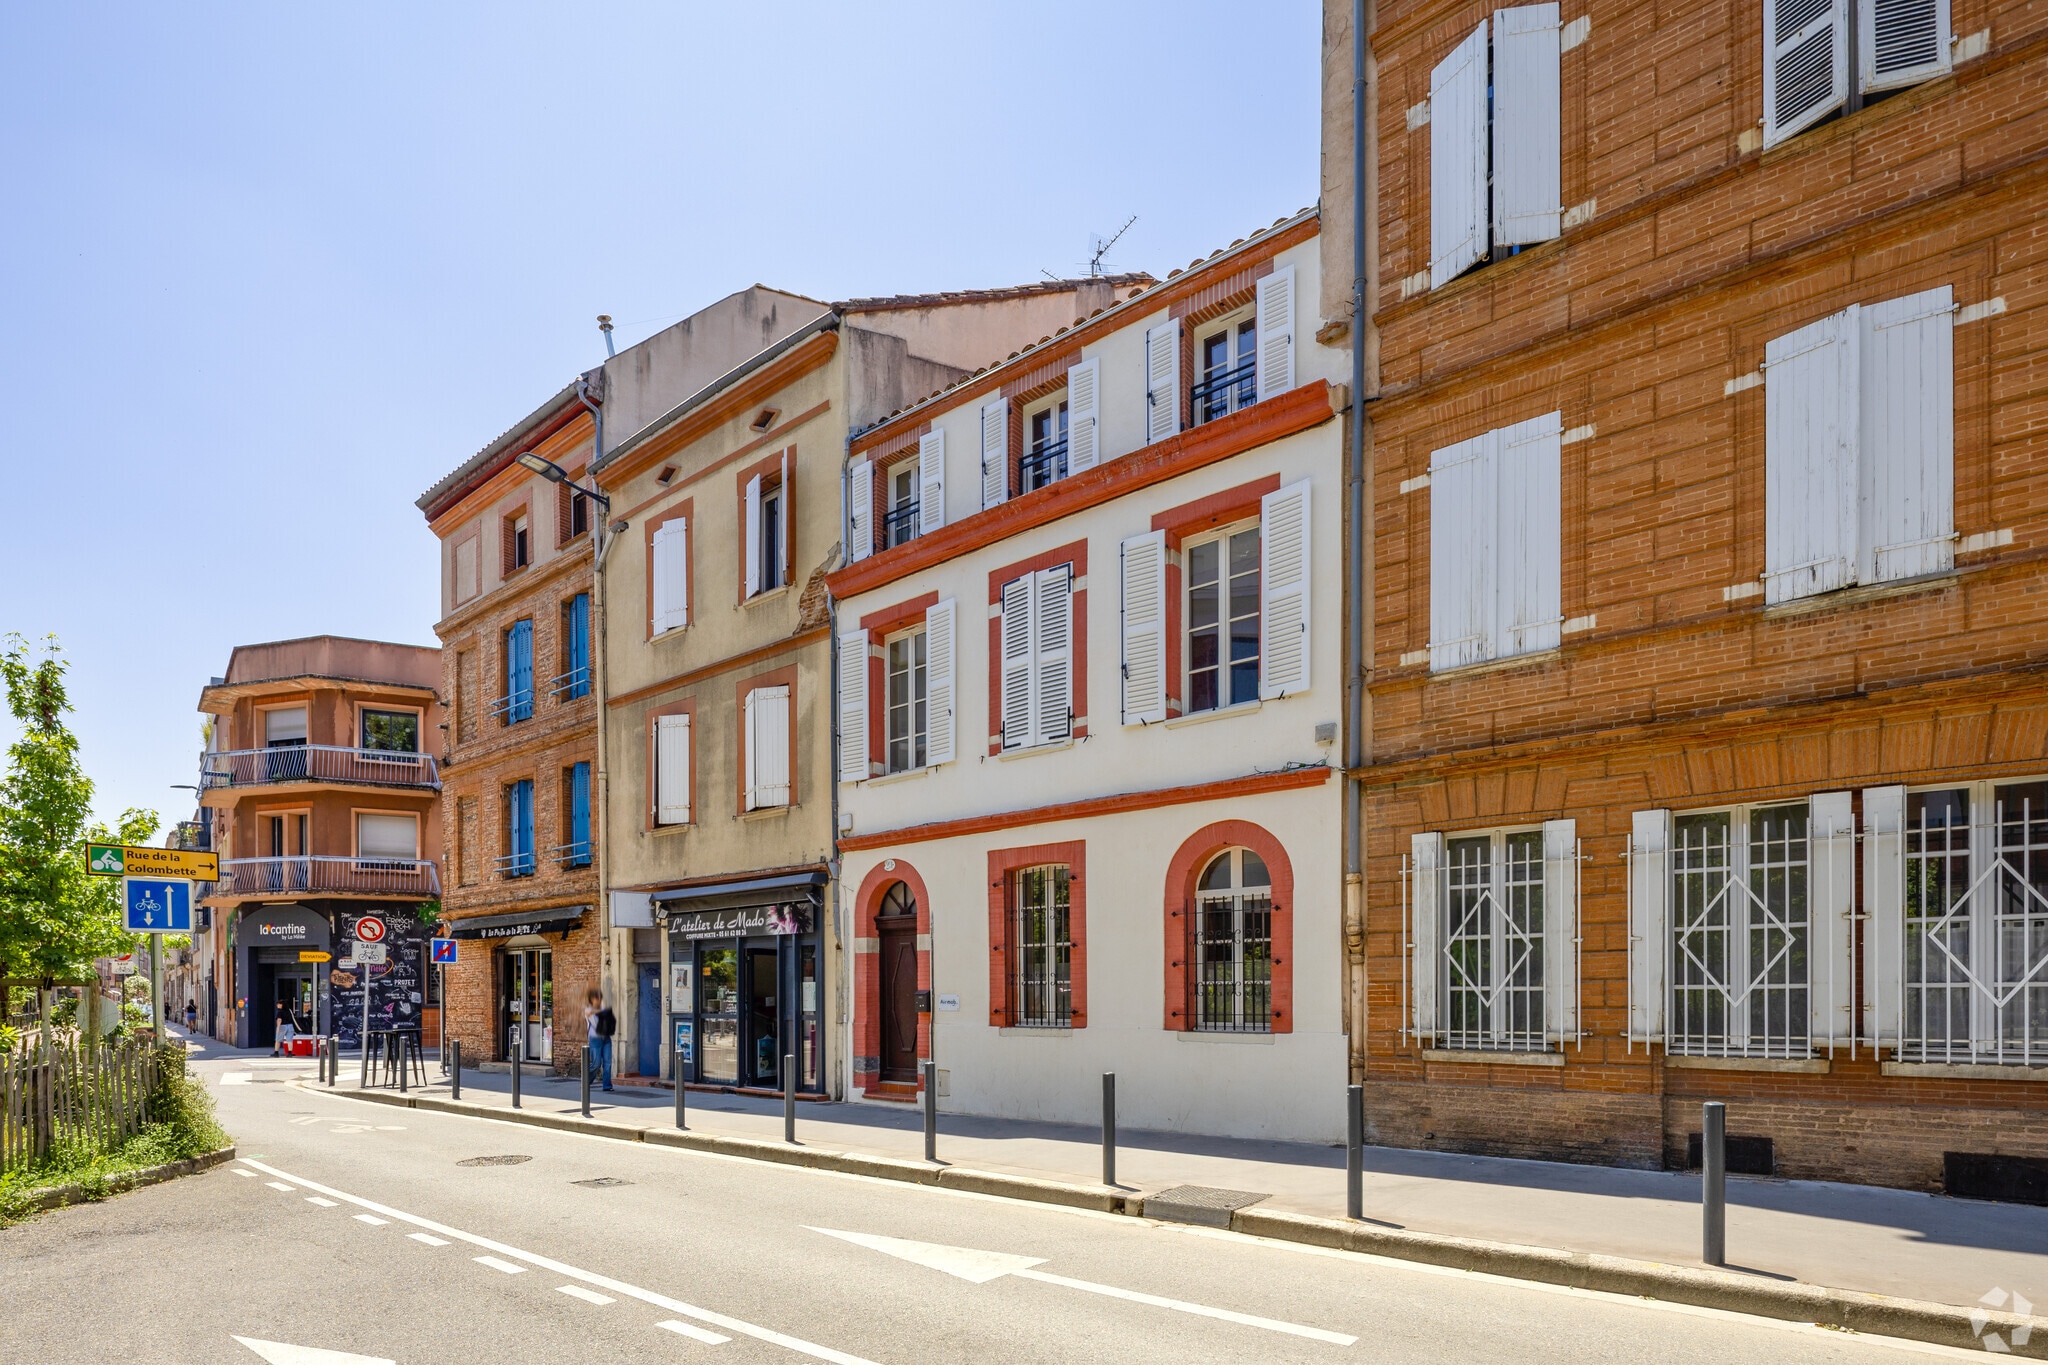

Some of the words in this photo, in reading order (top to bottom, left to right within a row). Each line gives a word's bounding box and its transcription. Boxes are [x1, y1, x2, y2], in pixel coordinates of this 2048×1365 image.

[126, 850, 149, 860] Rue
[152, 852, 167, 861] de
[170, 853, 180, 862] la
[127, 863, 197, 876] Colombette
[669, 914, 711, 933] L'atelier
[713, 913, 725, 929] de
[727, 909, 764, 929] Mado
[259, 924, 269, 935] la
[270, 923, 306, 935] cantine
